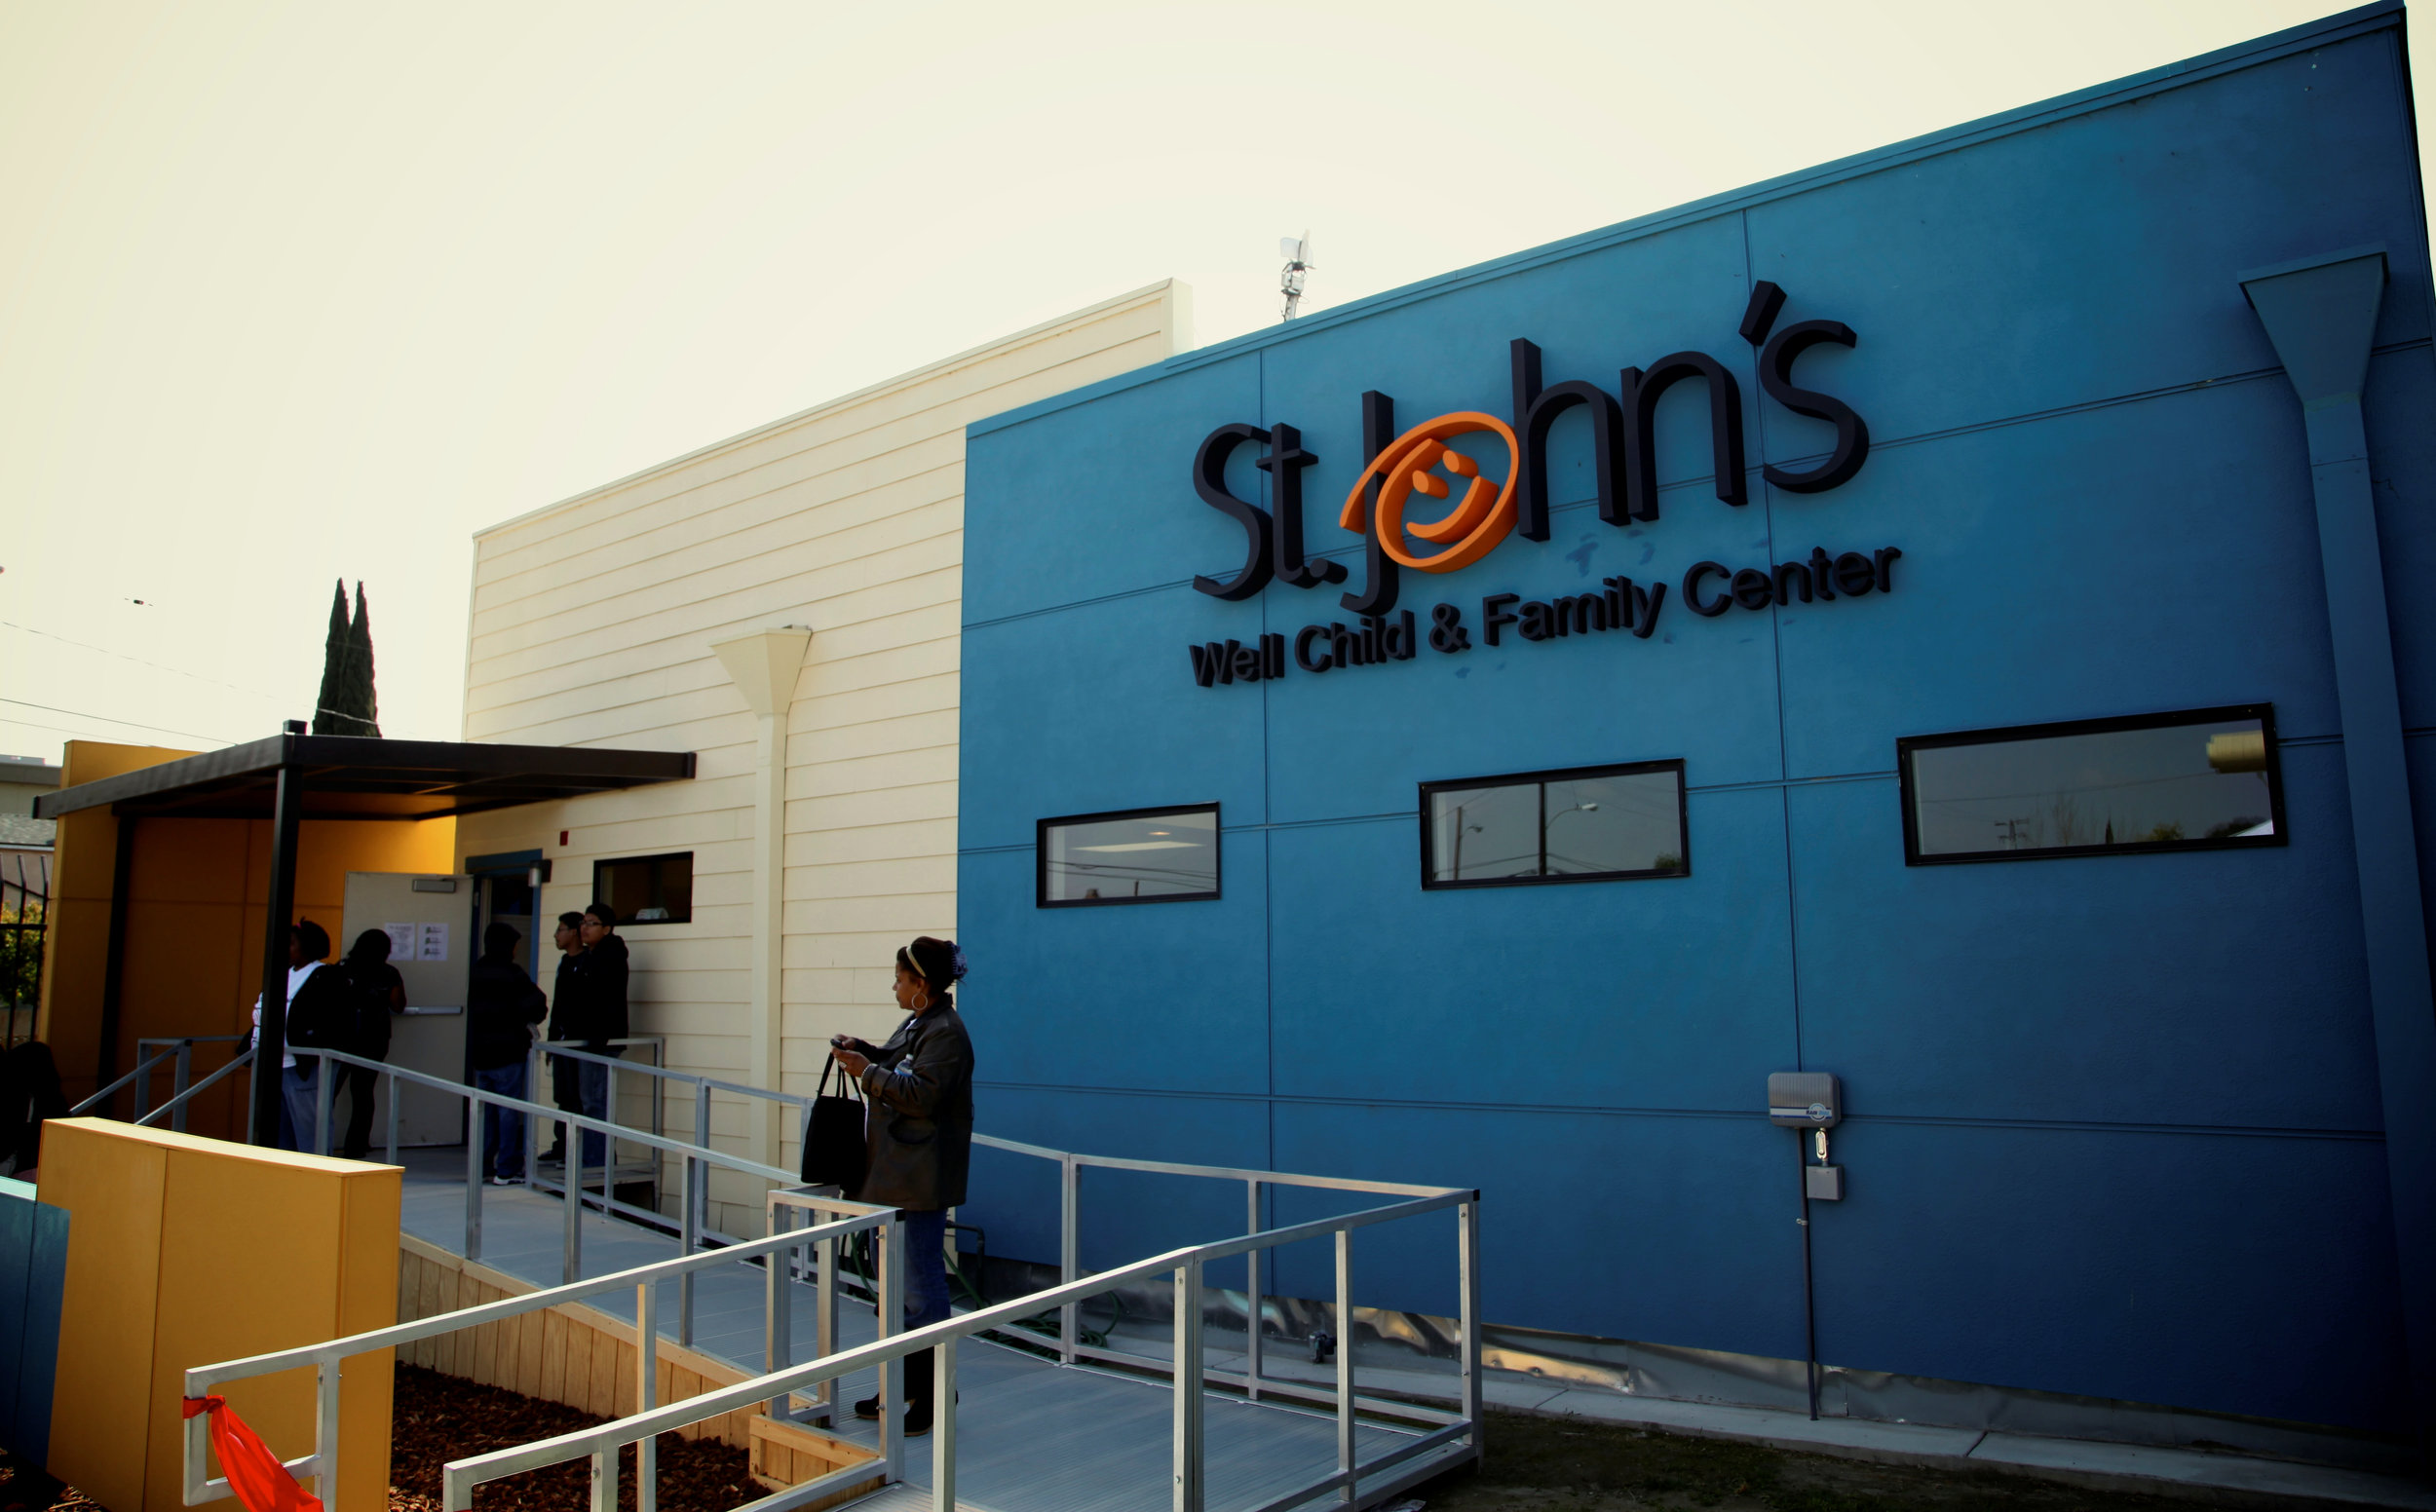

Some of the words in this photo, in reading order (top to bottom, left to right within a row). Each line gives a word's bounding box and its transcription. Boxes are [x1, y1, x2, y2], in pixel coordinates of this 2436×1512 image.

[1193, 422, 1349, 602] St.
[1339, 280, 1870, 616] John's
[1188, 632, 1285, 688] Well
[1294, 609, 1417, 673] Child
[1428, 602, 1472, 654] &
[1482, 574, 1668, 640] Family
[1682, 546, 1903, 618] Center
